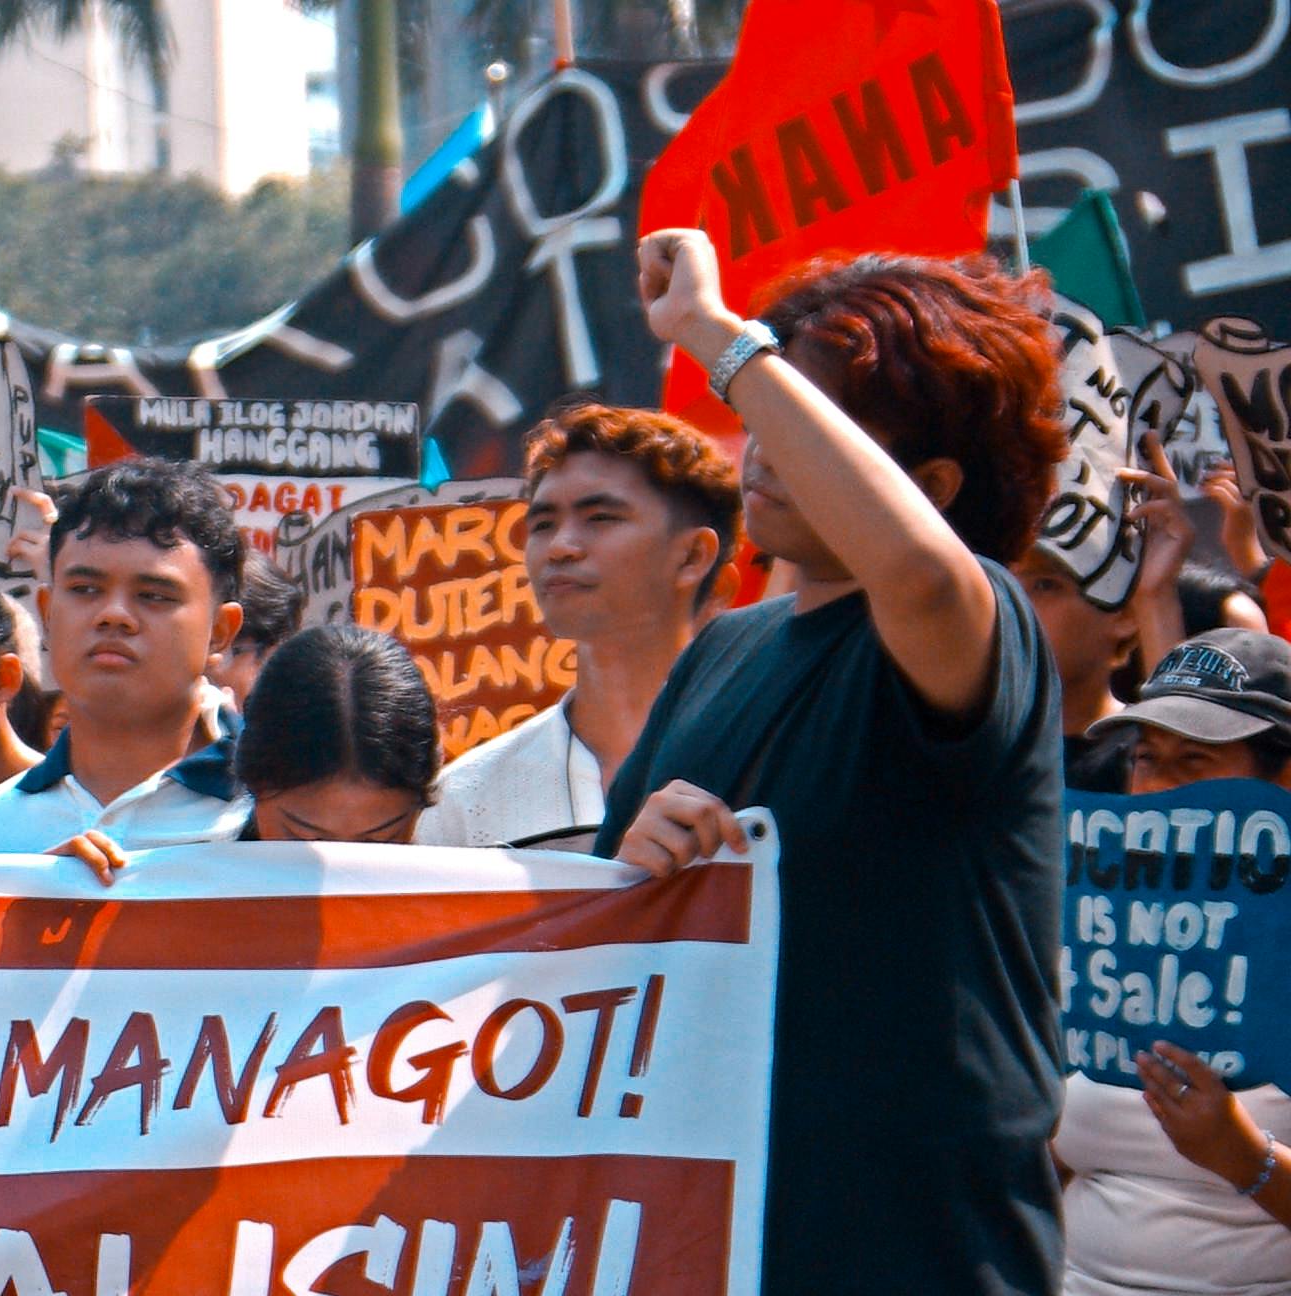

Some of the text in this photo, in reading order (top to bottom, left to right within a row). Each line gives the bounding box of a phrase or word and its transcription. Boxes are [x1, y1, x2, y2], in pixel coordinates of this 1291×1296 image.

[138, 399, 212, 427] MULA
[291, 401, 416, 434] JORDAN
[198, 427, 381, 471] HANGGANG
[1067, 807, 1291, 895] CATIO
[1079, 895, 1239, 951] IS NOT
